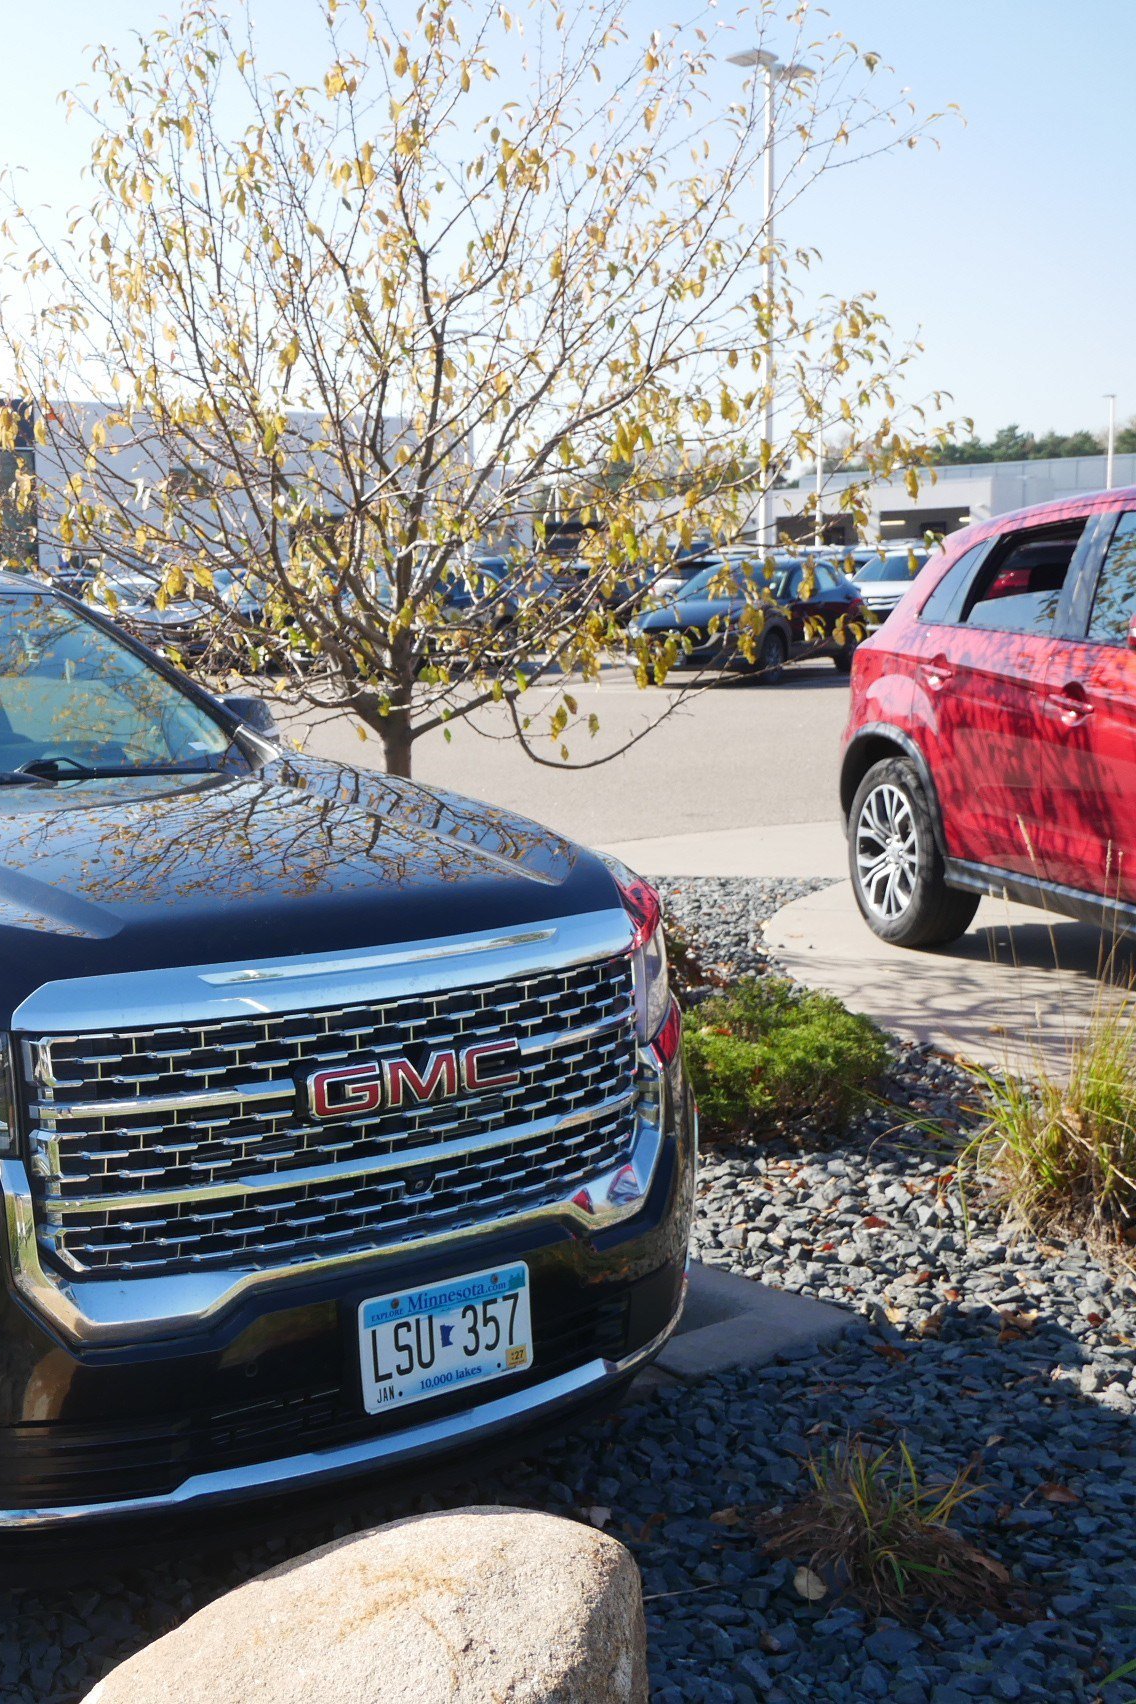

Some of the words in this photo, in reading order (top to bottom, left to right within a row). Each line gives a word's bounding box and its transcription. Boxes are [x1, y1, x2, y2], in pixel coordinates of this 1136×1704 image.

[307, 1037, 520, 1119] GMC
[371, 1308, 404, 1322] EXPLORE
[371, 1314, 435, 1383] LSU
[461, 1292, 519, 1357] 357
[419, 1374, 453, 1390] 10,000
[455, 1365, 482, 1381] lakes
[376, 1385, 395, 1404] JAN
